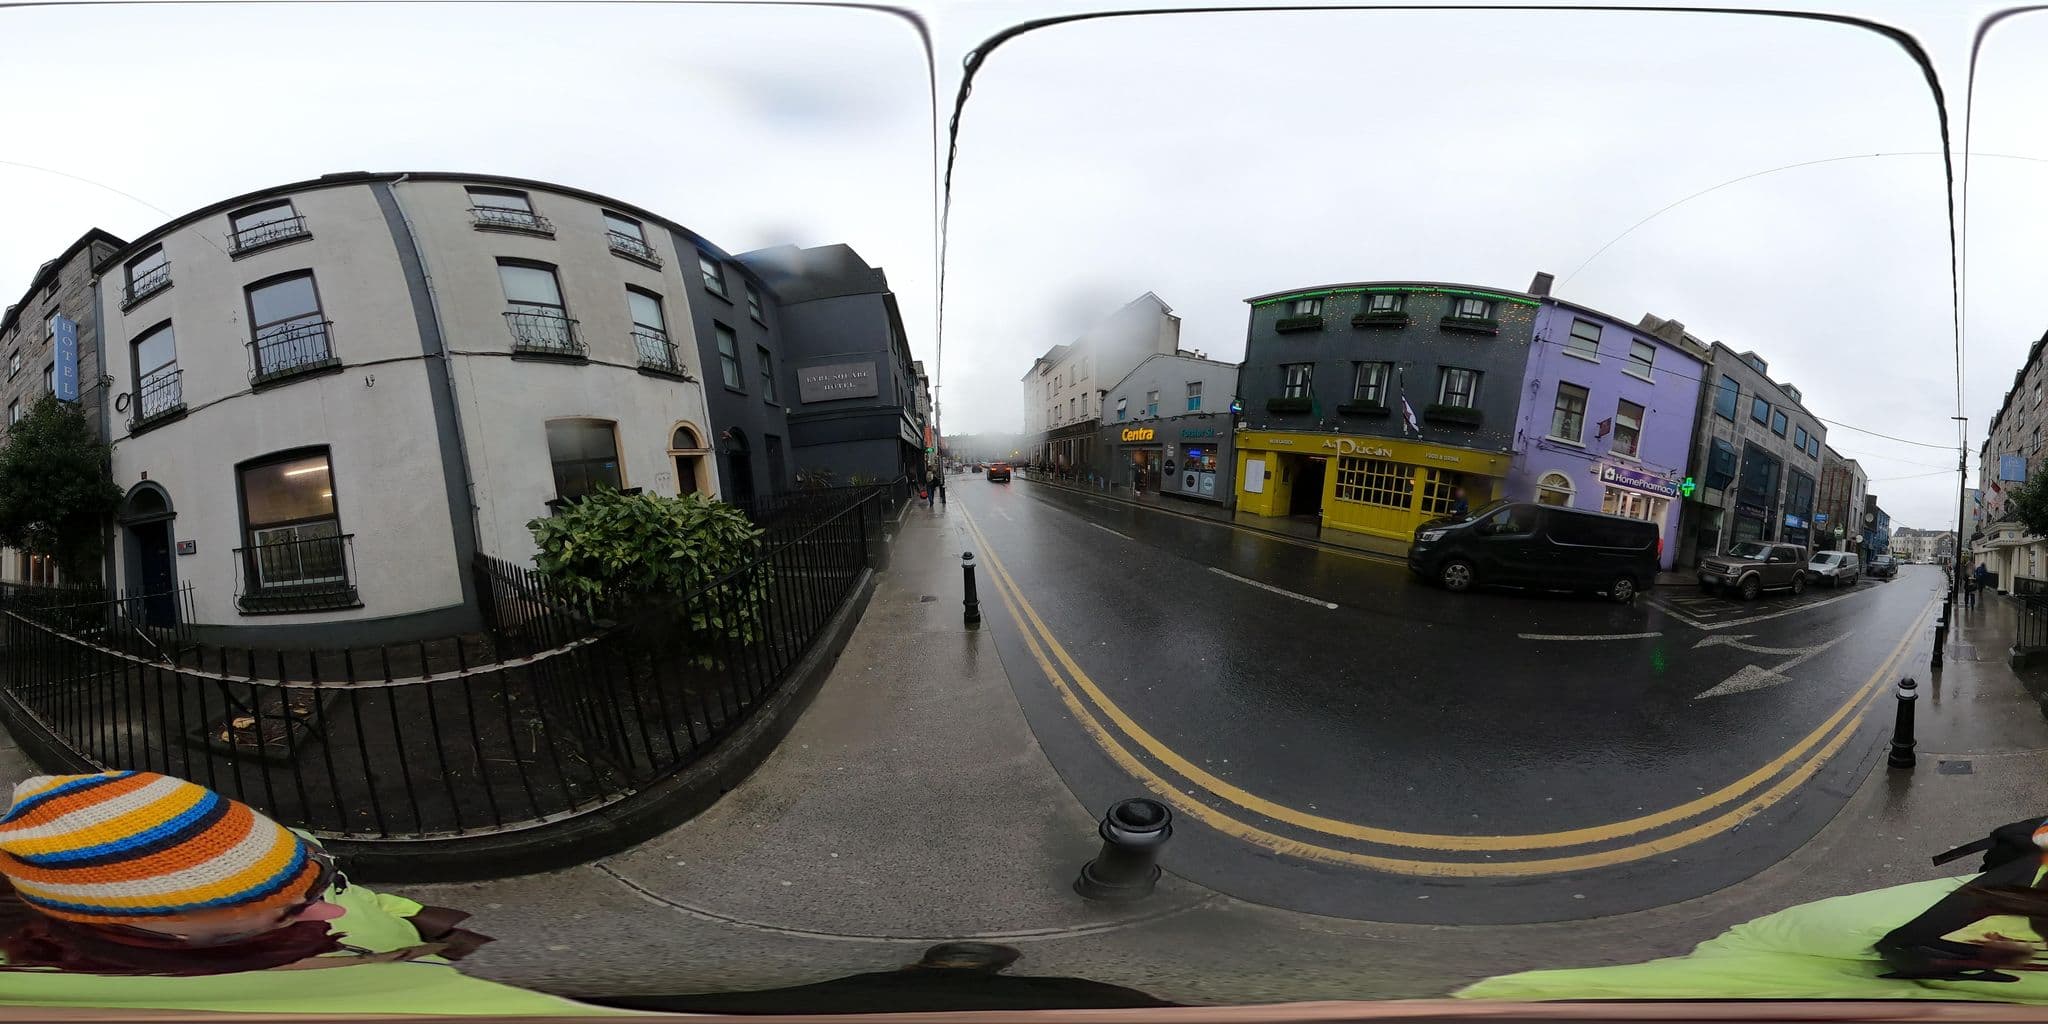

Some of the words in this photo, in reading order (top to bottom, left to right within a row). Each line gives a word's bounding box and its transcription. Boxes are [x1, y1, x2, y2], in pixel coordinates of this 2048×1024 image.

[62, 322, 73, 395] HOTEL
[824, 382, 856, 390] HOTEL
[1121, 428, 1154, 441] Centra
[1615, 473, 1676, 495] HomePharmacy
